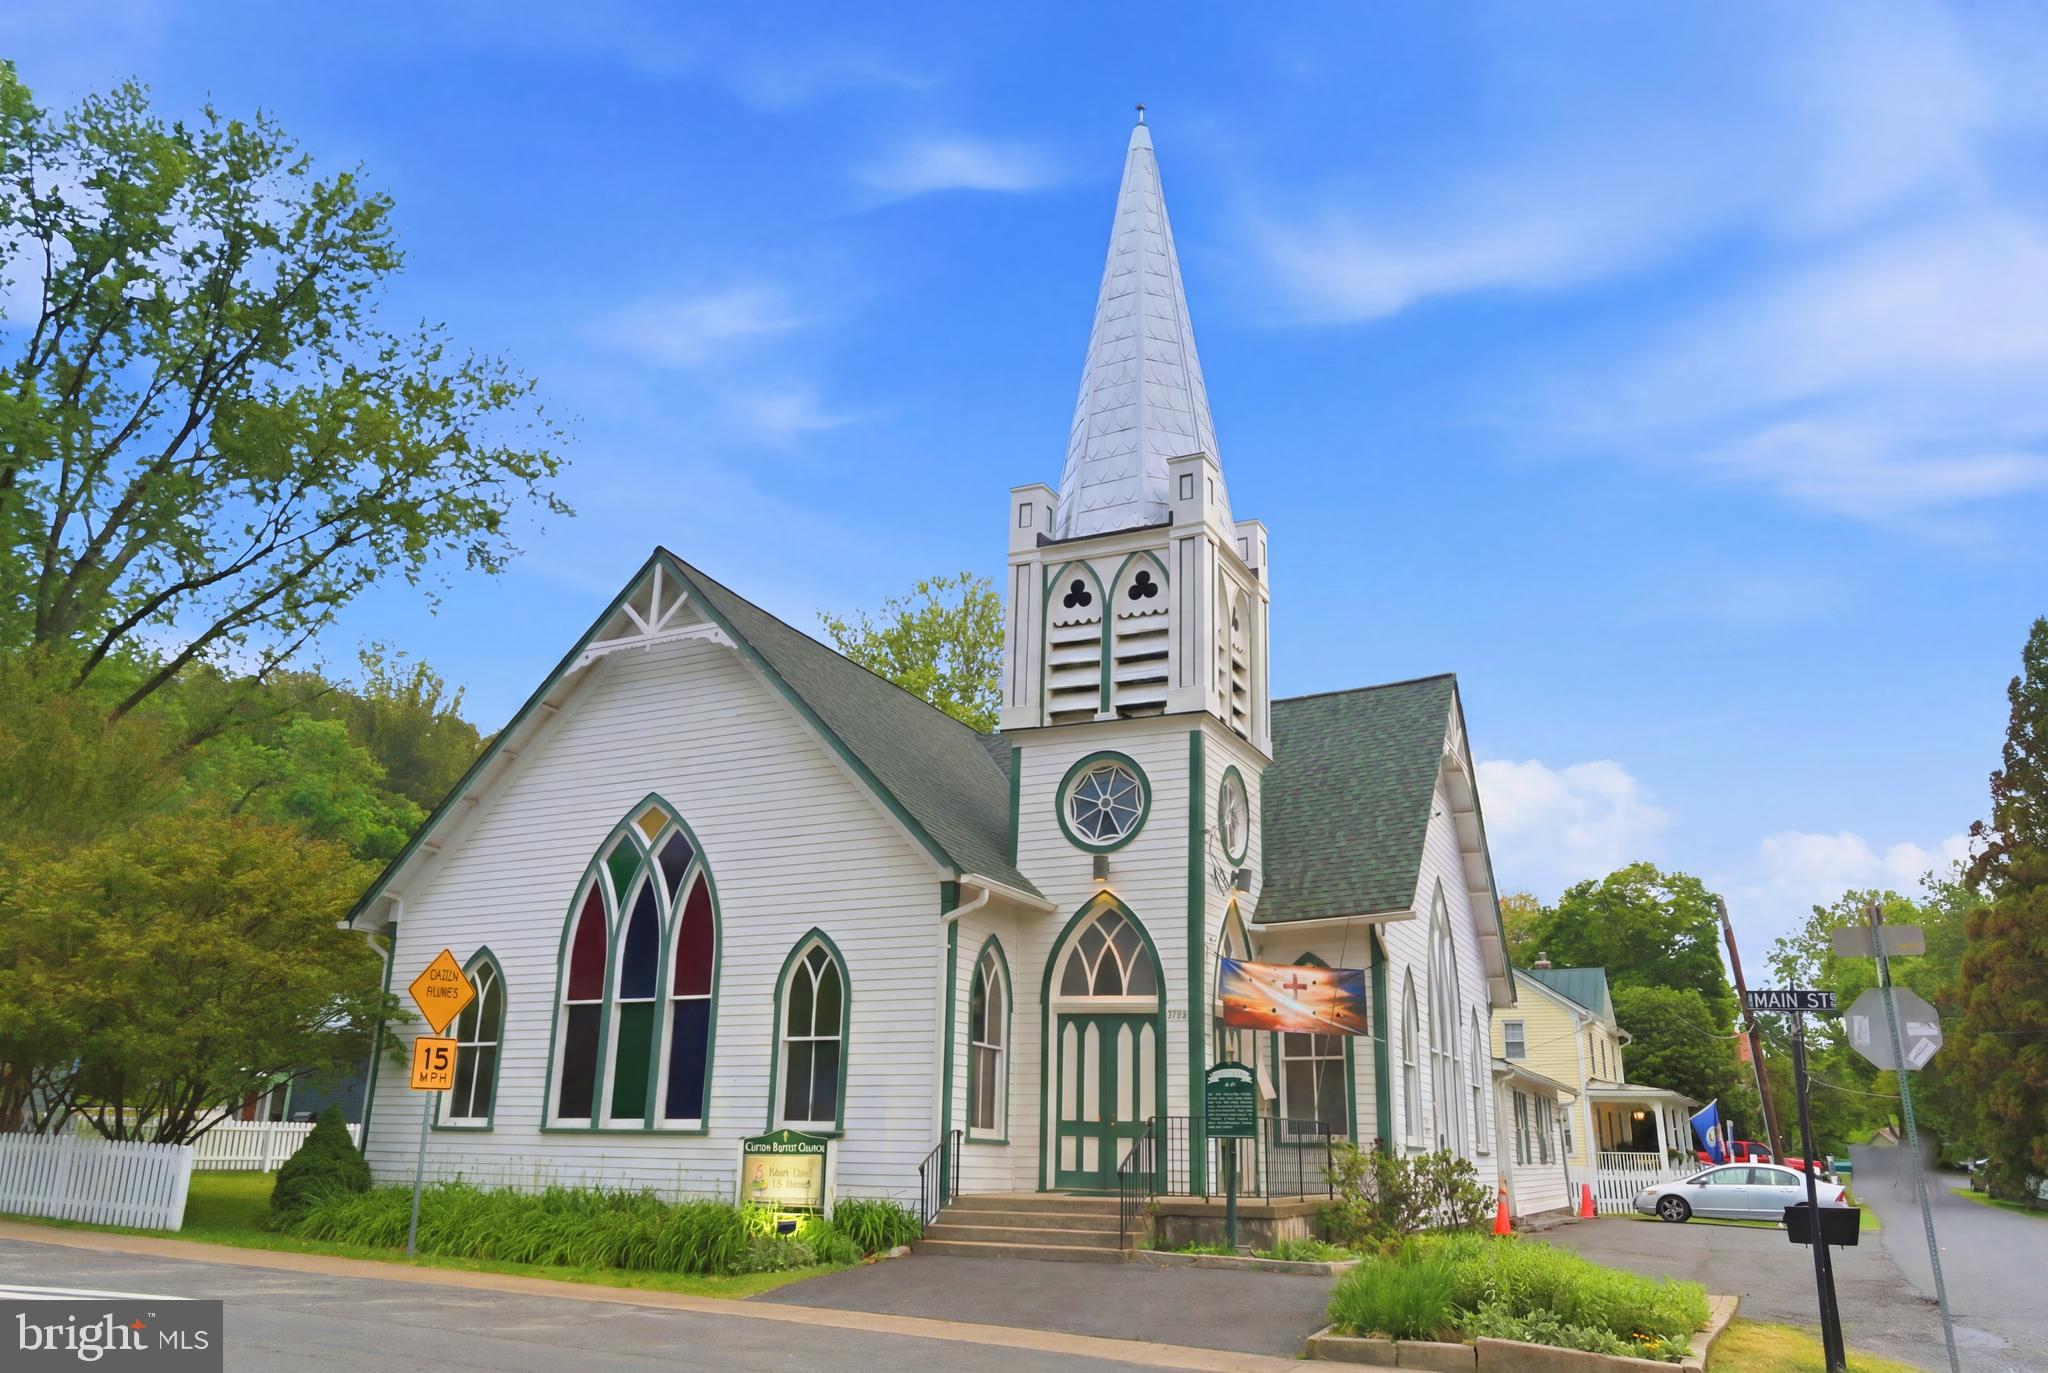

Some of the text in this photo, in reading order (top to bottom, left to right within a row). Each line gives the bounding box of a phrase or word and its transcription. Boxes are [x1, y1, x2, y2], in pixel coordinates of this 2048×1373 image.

[1754, 992, 1798, 1008] MAIN
[1807, 992, 1829, 1008] ST
[424, 1047, 449, 1071] 15
[419, 1072, 448, 1084] MPH
